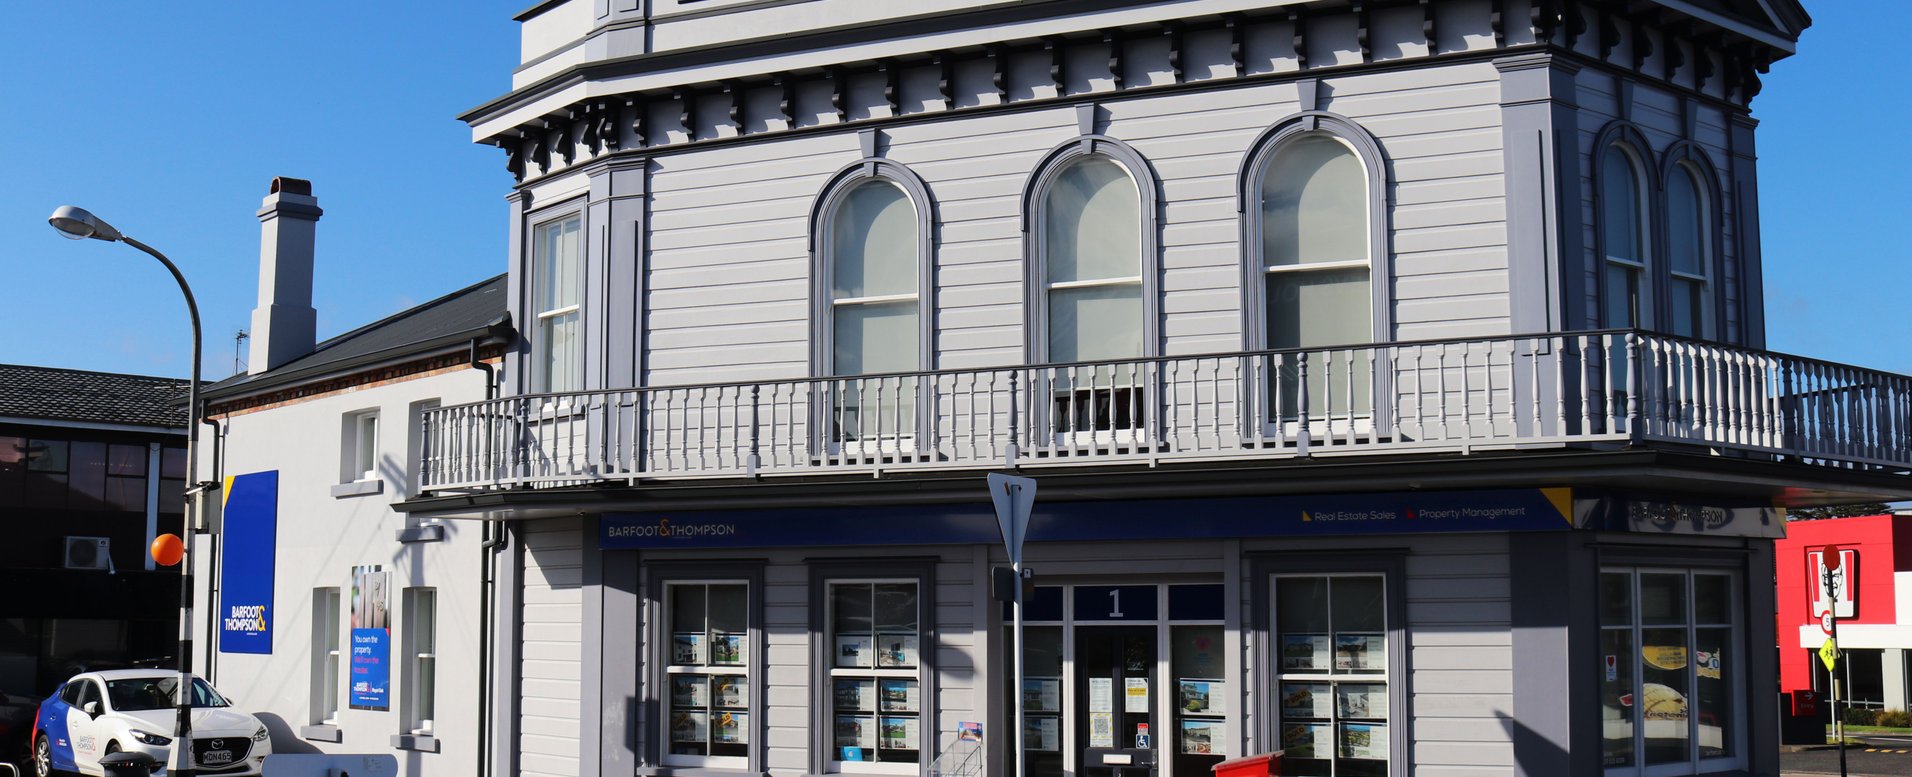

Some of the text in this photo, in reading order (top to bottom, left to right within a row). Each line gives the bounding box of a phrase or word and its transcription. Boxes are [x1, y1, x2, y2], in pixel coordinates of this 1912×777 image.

[1314, 510, 1397, 521] Real Estate Sales
[1419, 507, 1526, 520] Property Management
[1108, 589, 1124, 617] 1
[224, 618, 260, 631] THOMPSON
